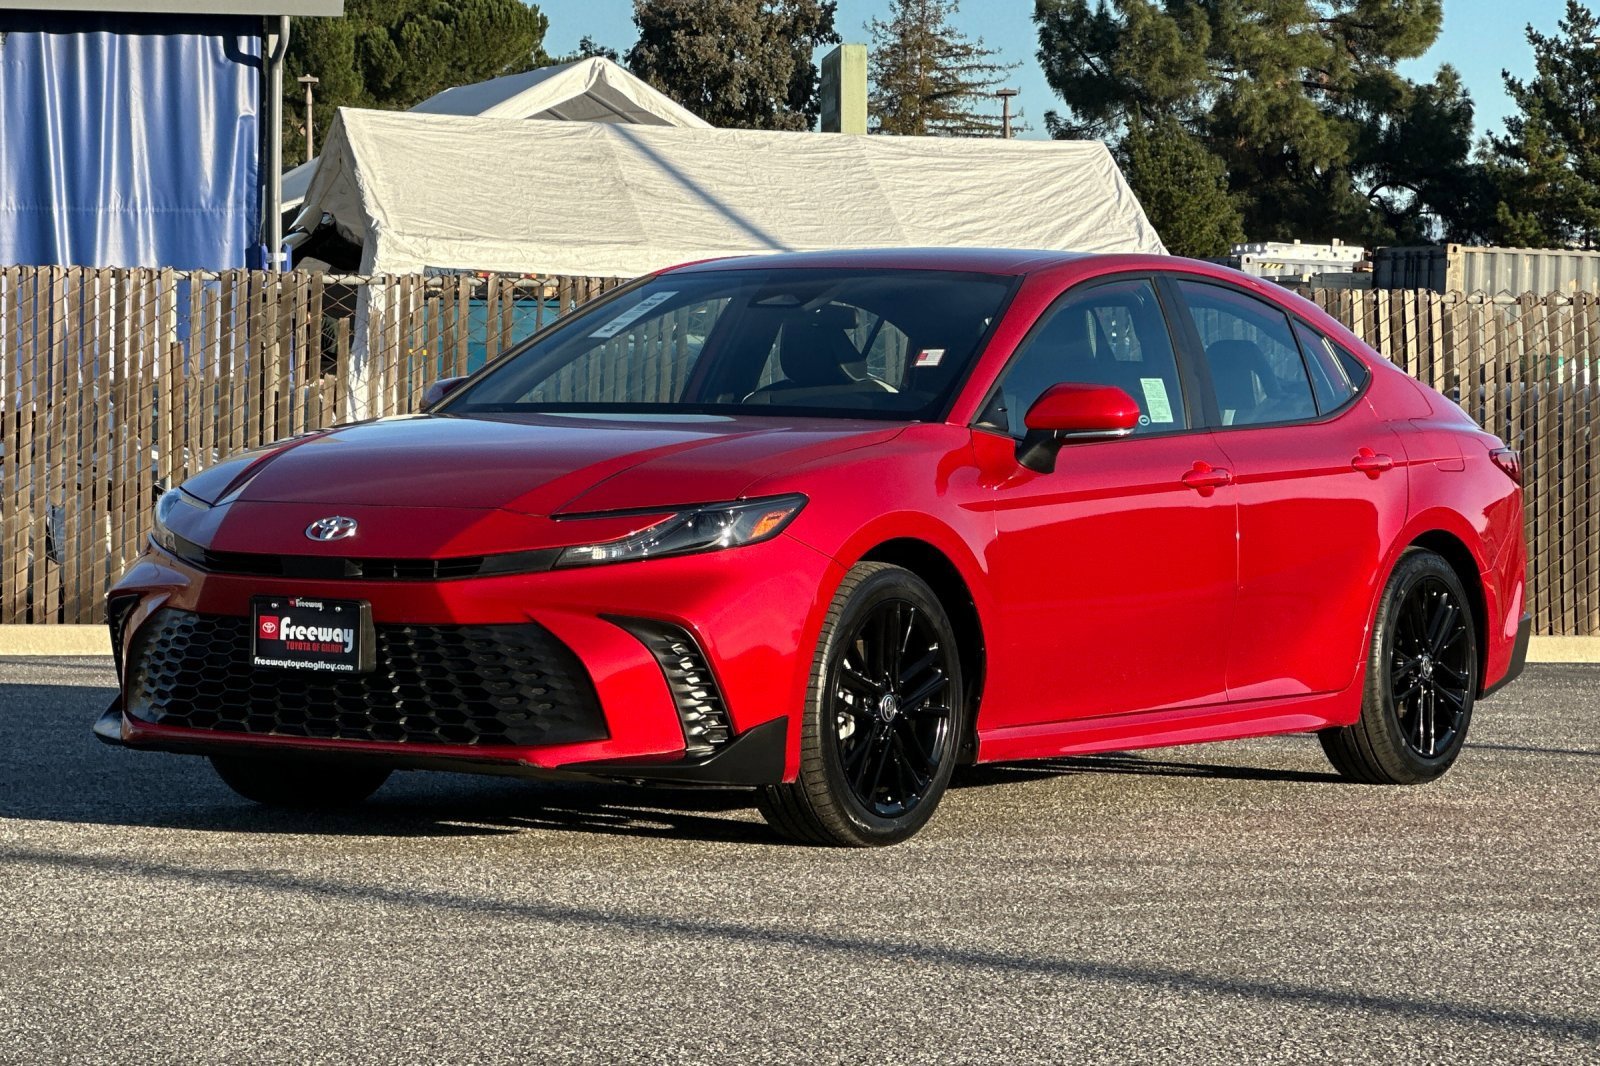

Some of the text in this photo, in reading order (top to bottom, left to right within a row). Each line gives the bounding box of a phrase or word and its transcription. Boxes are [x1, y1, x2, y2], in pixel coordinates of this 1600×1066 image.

[280, 617, 354, 653] freeway
[286, 640, 311, 650] TOYOTA
[312, 642, 320, 652] OF
[254, 656, 353, 671] freewaytoyotagilroy.com
